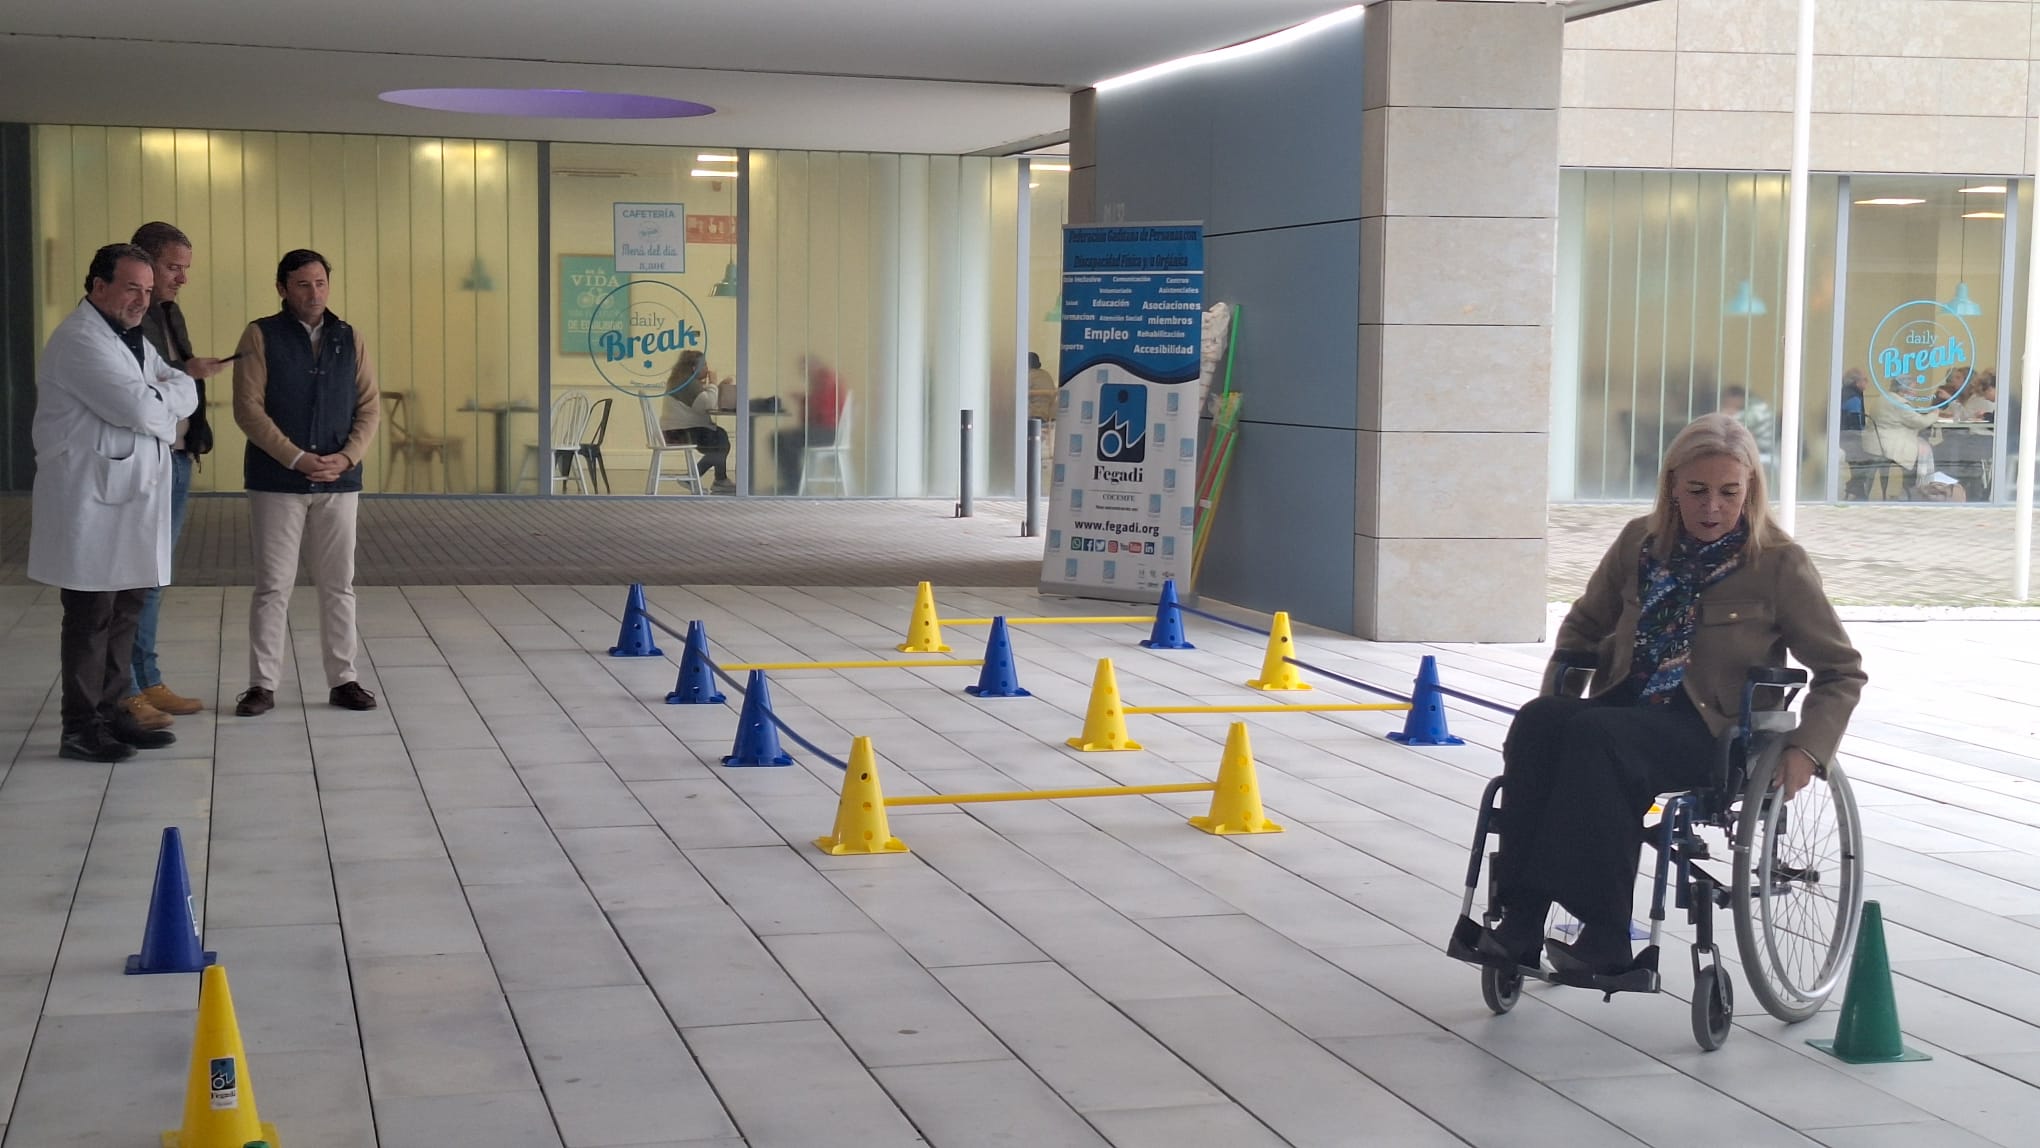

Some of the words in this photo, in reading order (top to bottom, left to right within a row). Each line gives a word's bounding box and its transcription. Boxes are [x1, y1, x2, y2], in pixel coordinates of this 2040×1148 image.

[571, 274, 619, 287] VIDA
[1092, 299, 1130, 307] Educación
[1142, 300, 1201, 310] Asociaciones
[629, 311, 665, 329] daily
[1147, 315, 1193, 325] miembros
[599, 319, 700, 362] Break
[1084, 327, 1129, 343] Empleo
[1905, 329, 1938, 347] daily
[1133, 344, 1194, 354] Accesibilidad
[1878, 336, 1967, 378] Break
[1093, 465, 1144, 485] Fegadi
[1074, 520, 1160, 537] www.fegadi.org
